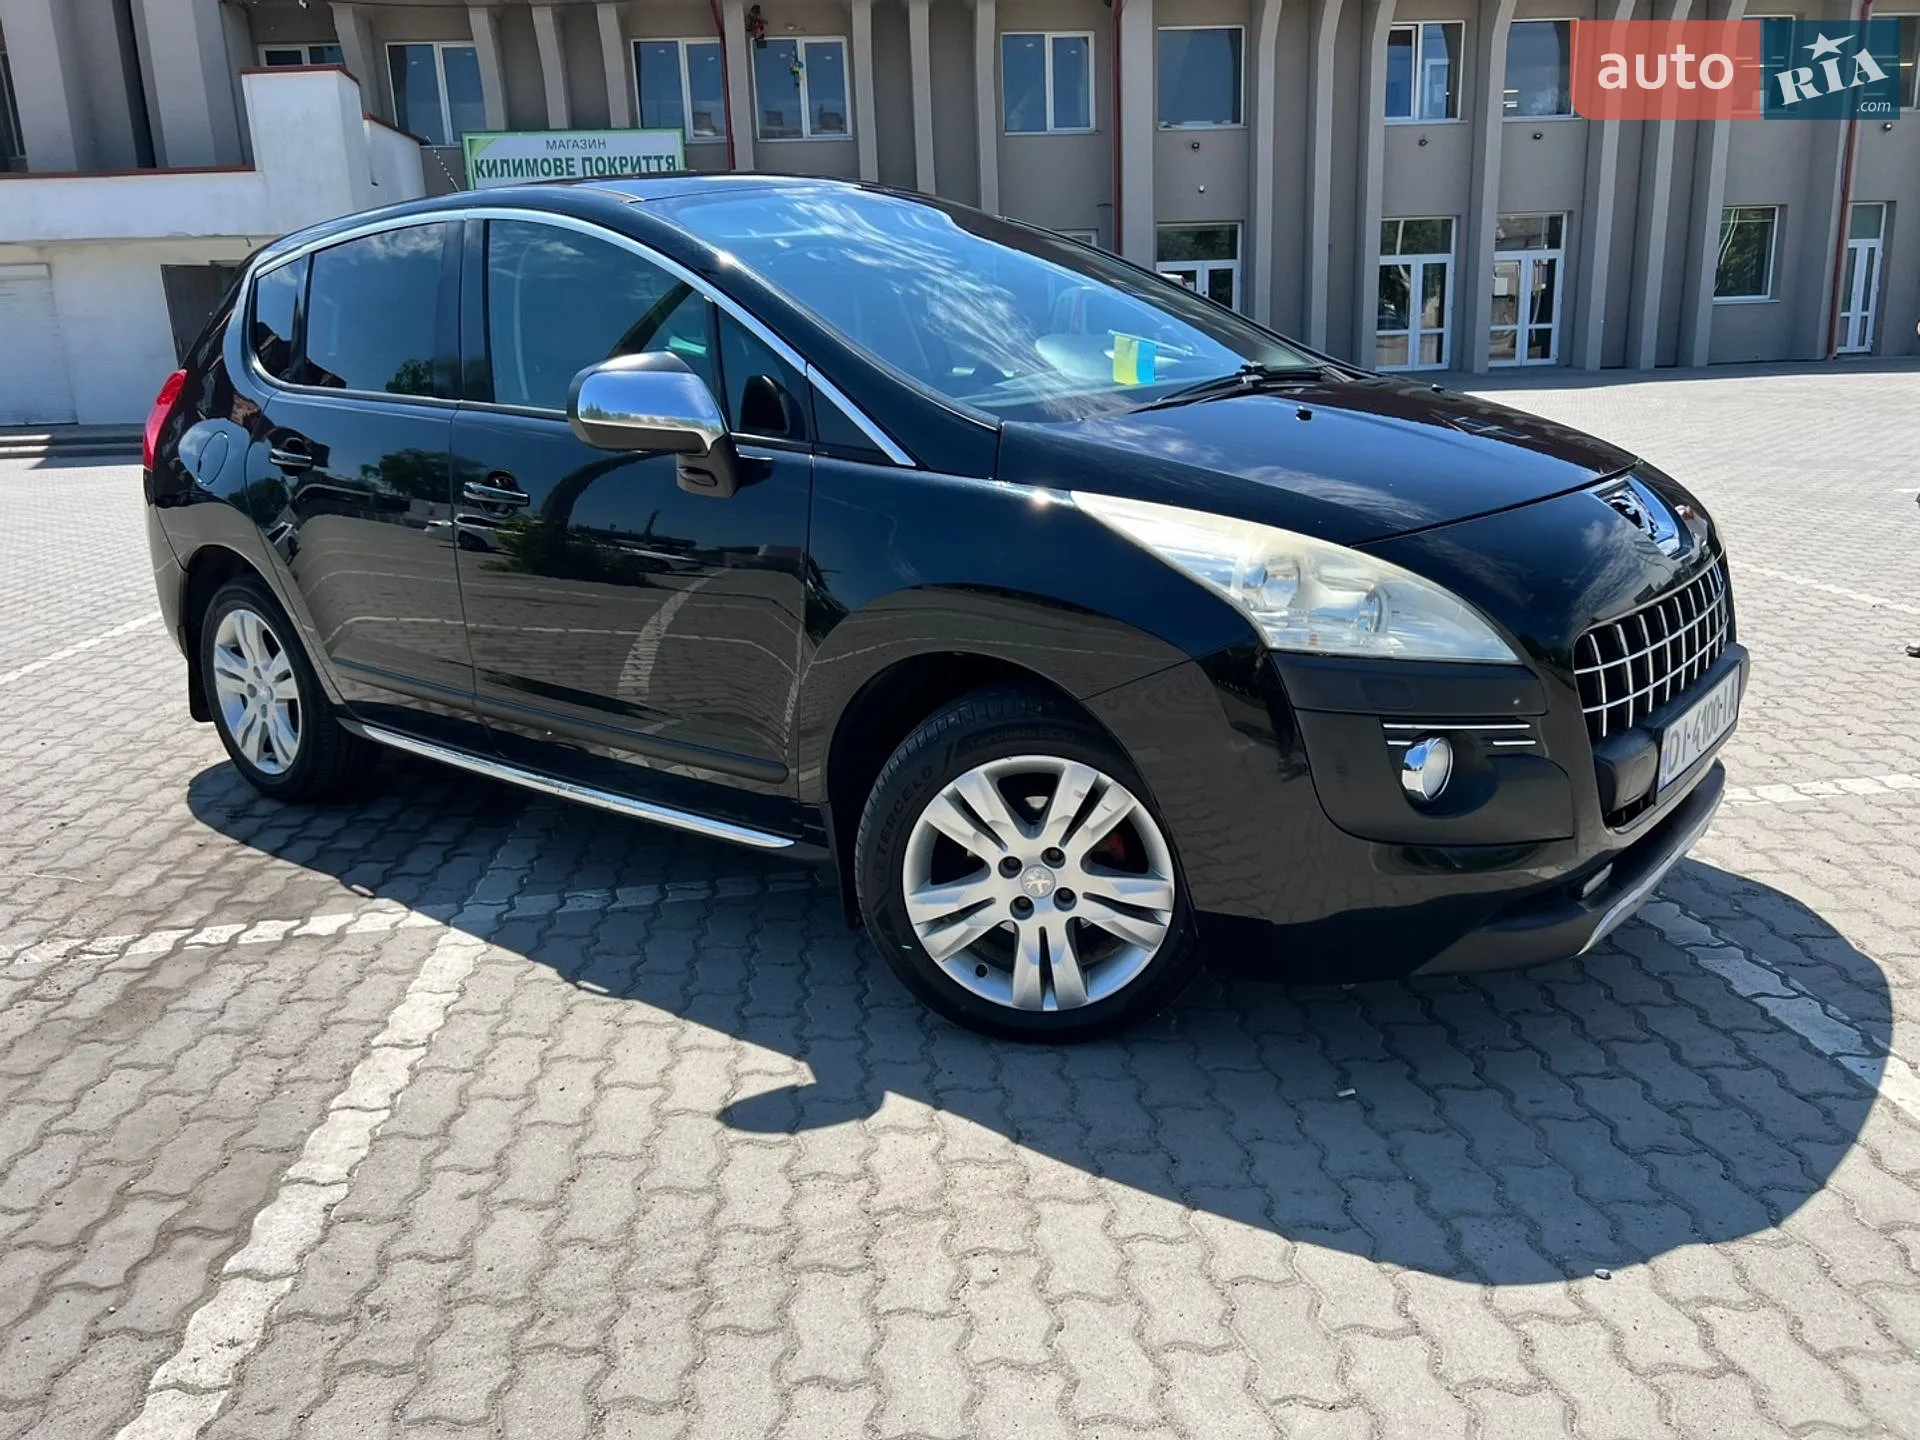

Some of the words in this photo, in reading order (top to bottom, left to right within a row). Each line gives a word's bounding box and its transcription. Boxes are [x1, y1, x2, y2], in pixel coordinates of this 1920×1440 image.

[545, 139, 607, 151] МАГАЗИН
[474, 156, 576, 180] КИЛИМОВЕ
[582, 154, 677, 177] ПОКРИТТЯ
[876, 765, 933, 857] TERCELO
